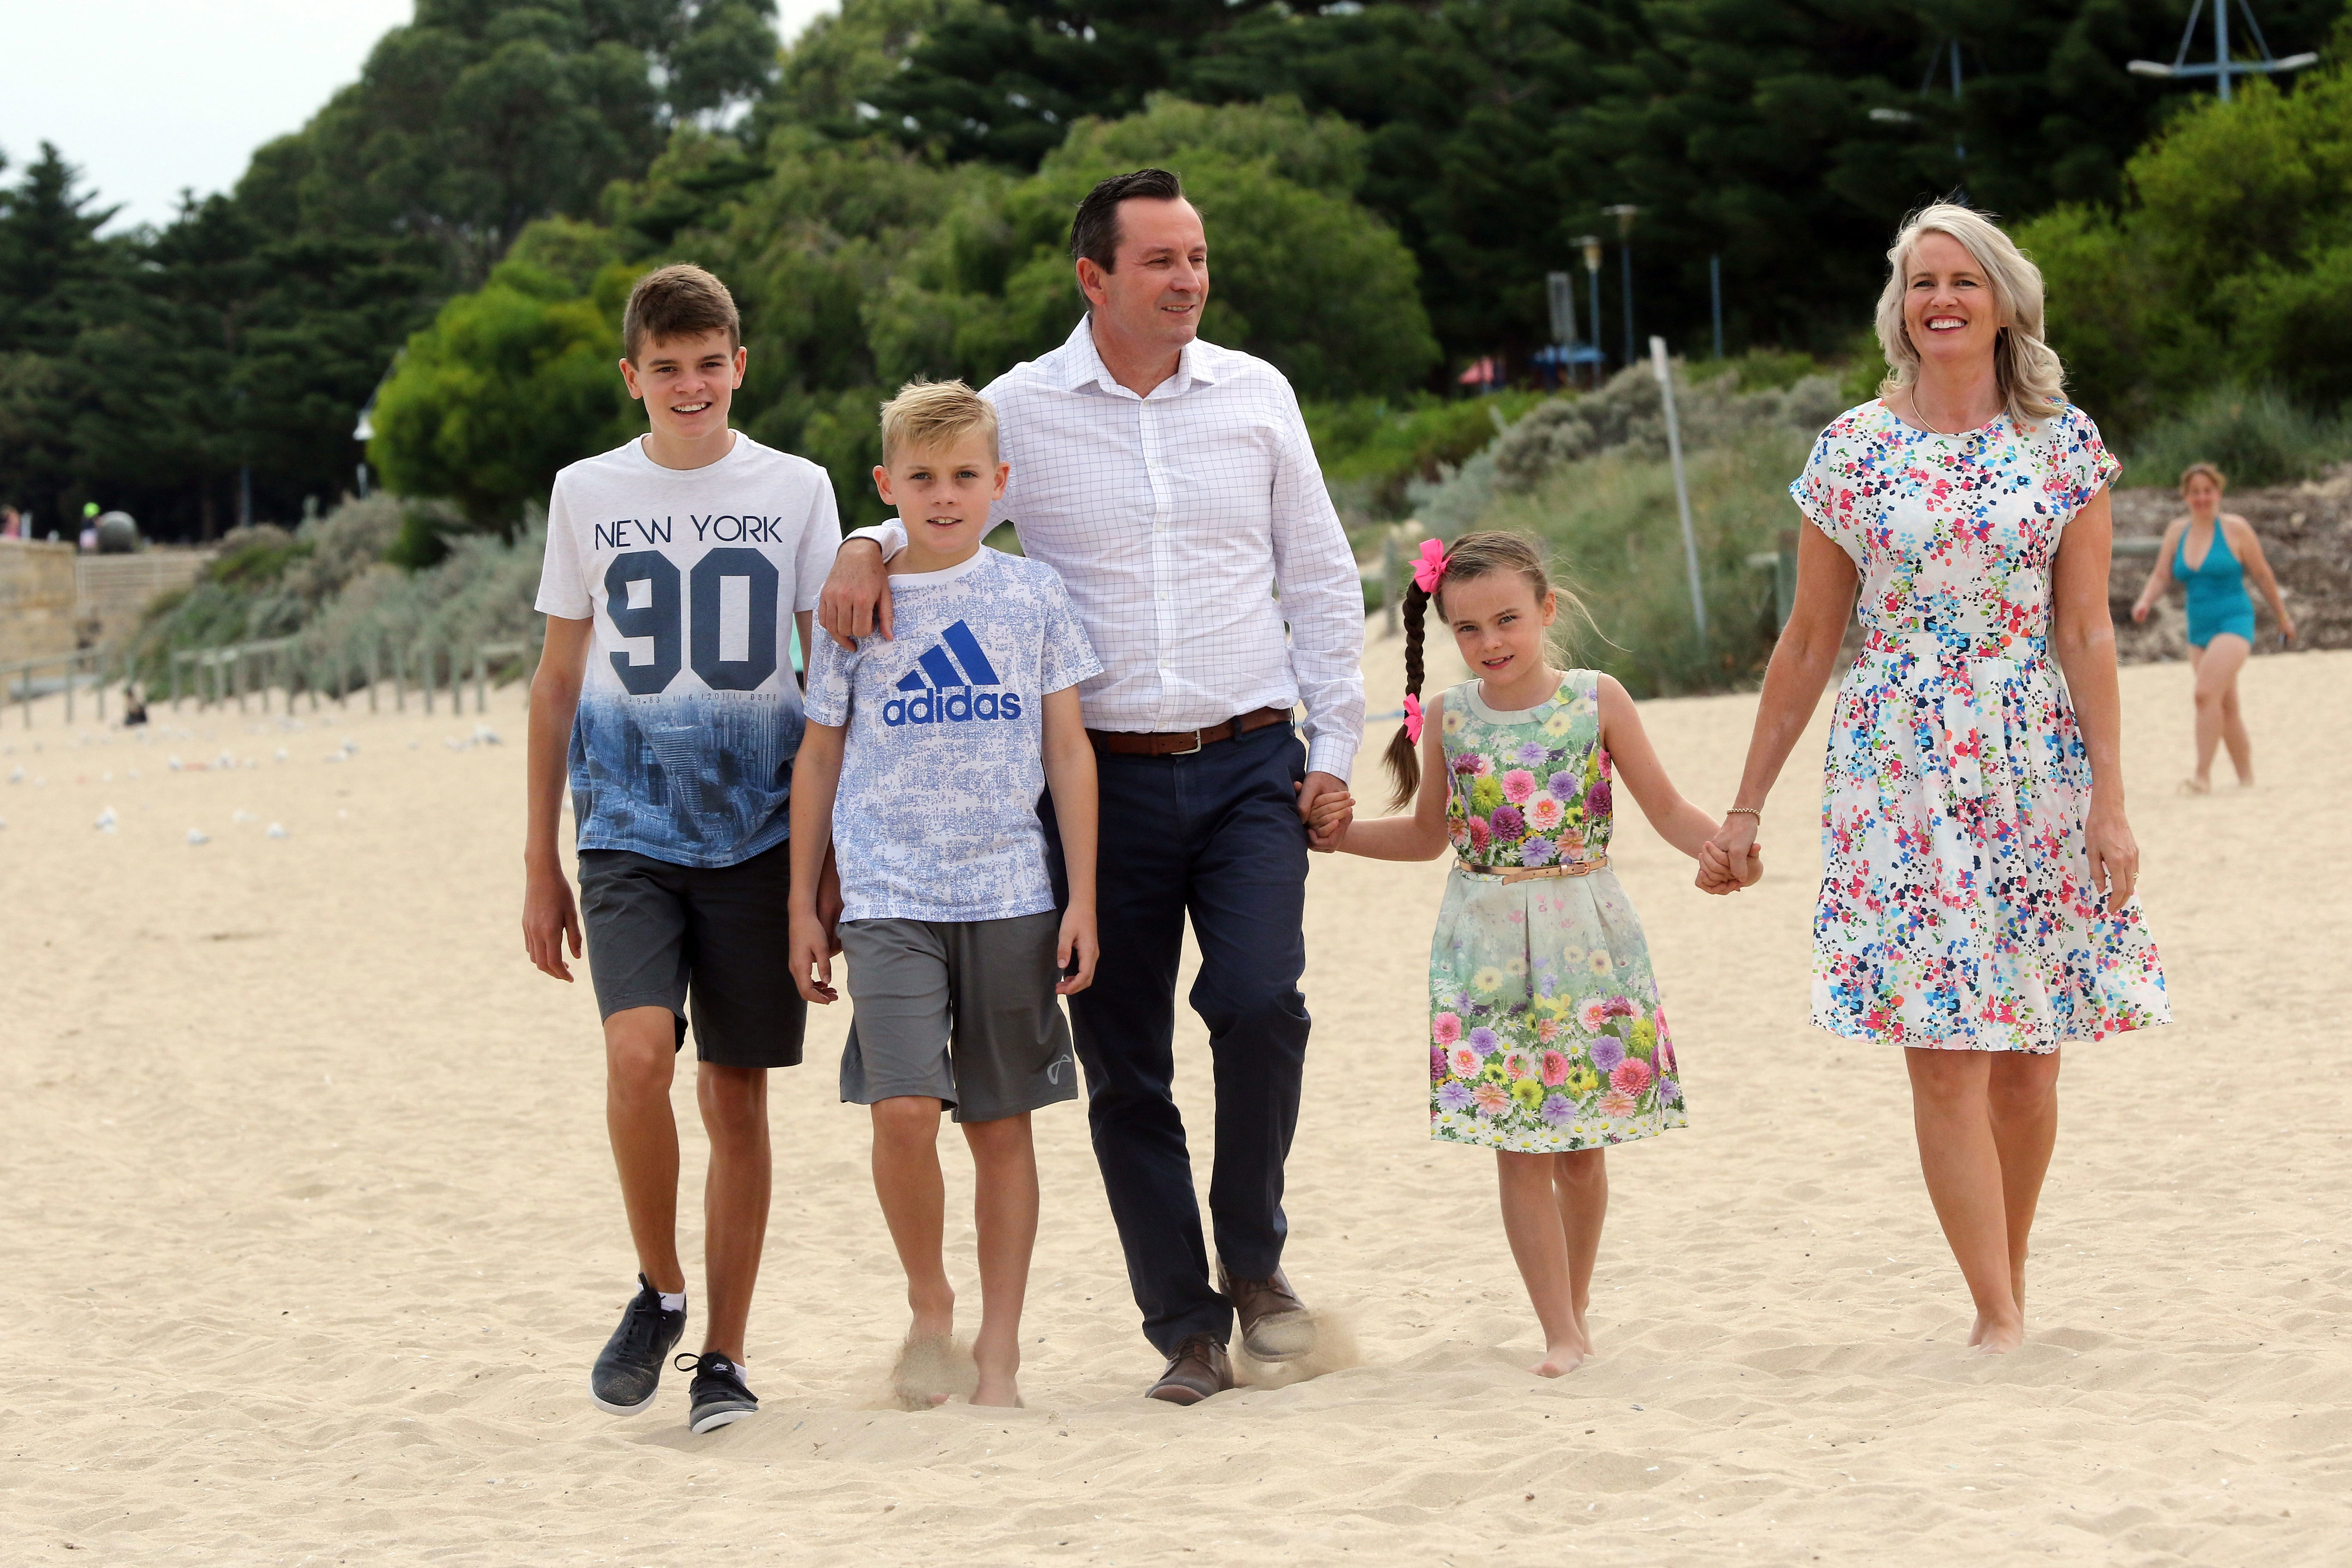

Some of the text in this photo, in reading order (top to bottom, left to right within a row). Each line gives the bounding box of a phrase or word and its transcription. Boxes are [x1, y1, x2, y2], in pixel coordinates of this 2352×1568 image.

[595, 515, 783, 550] NEW YORK
[604, 548, 779, 695] 90
[883, 686, 1021, 727] adidas
